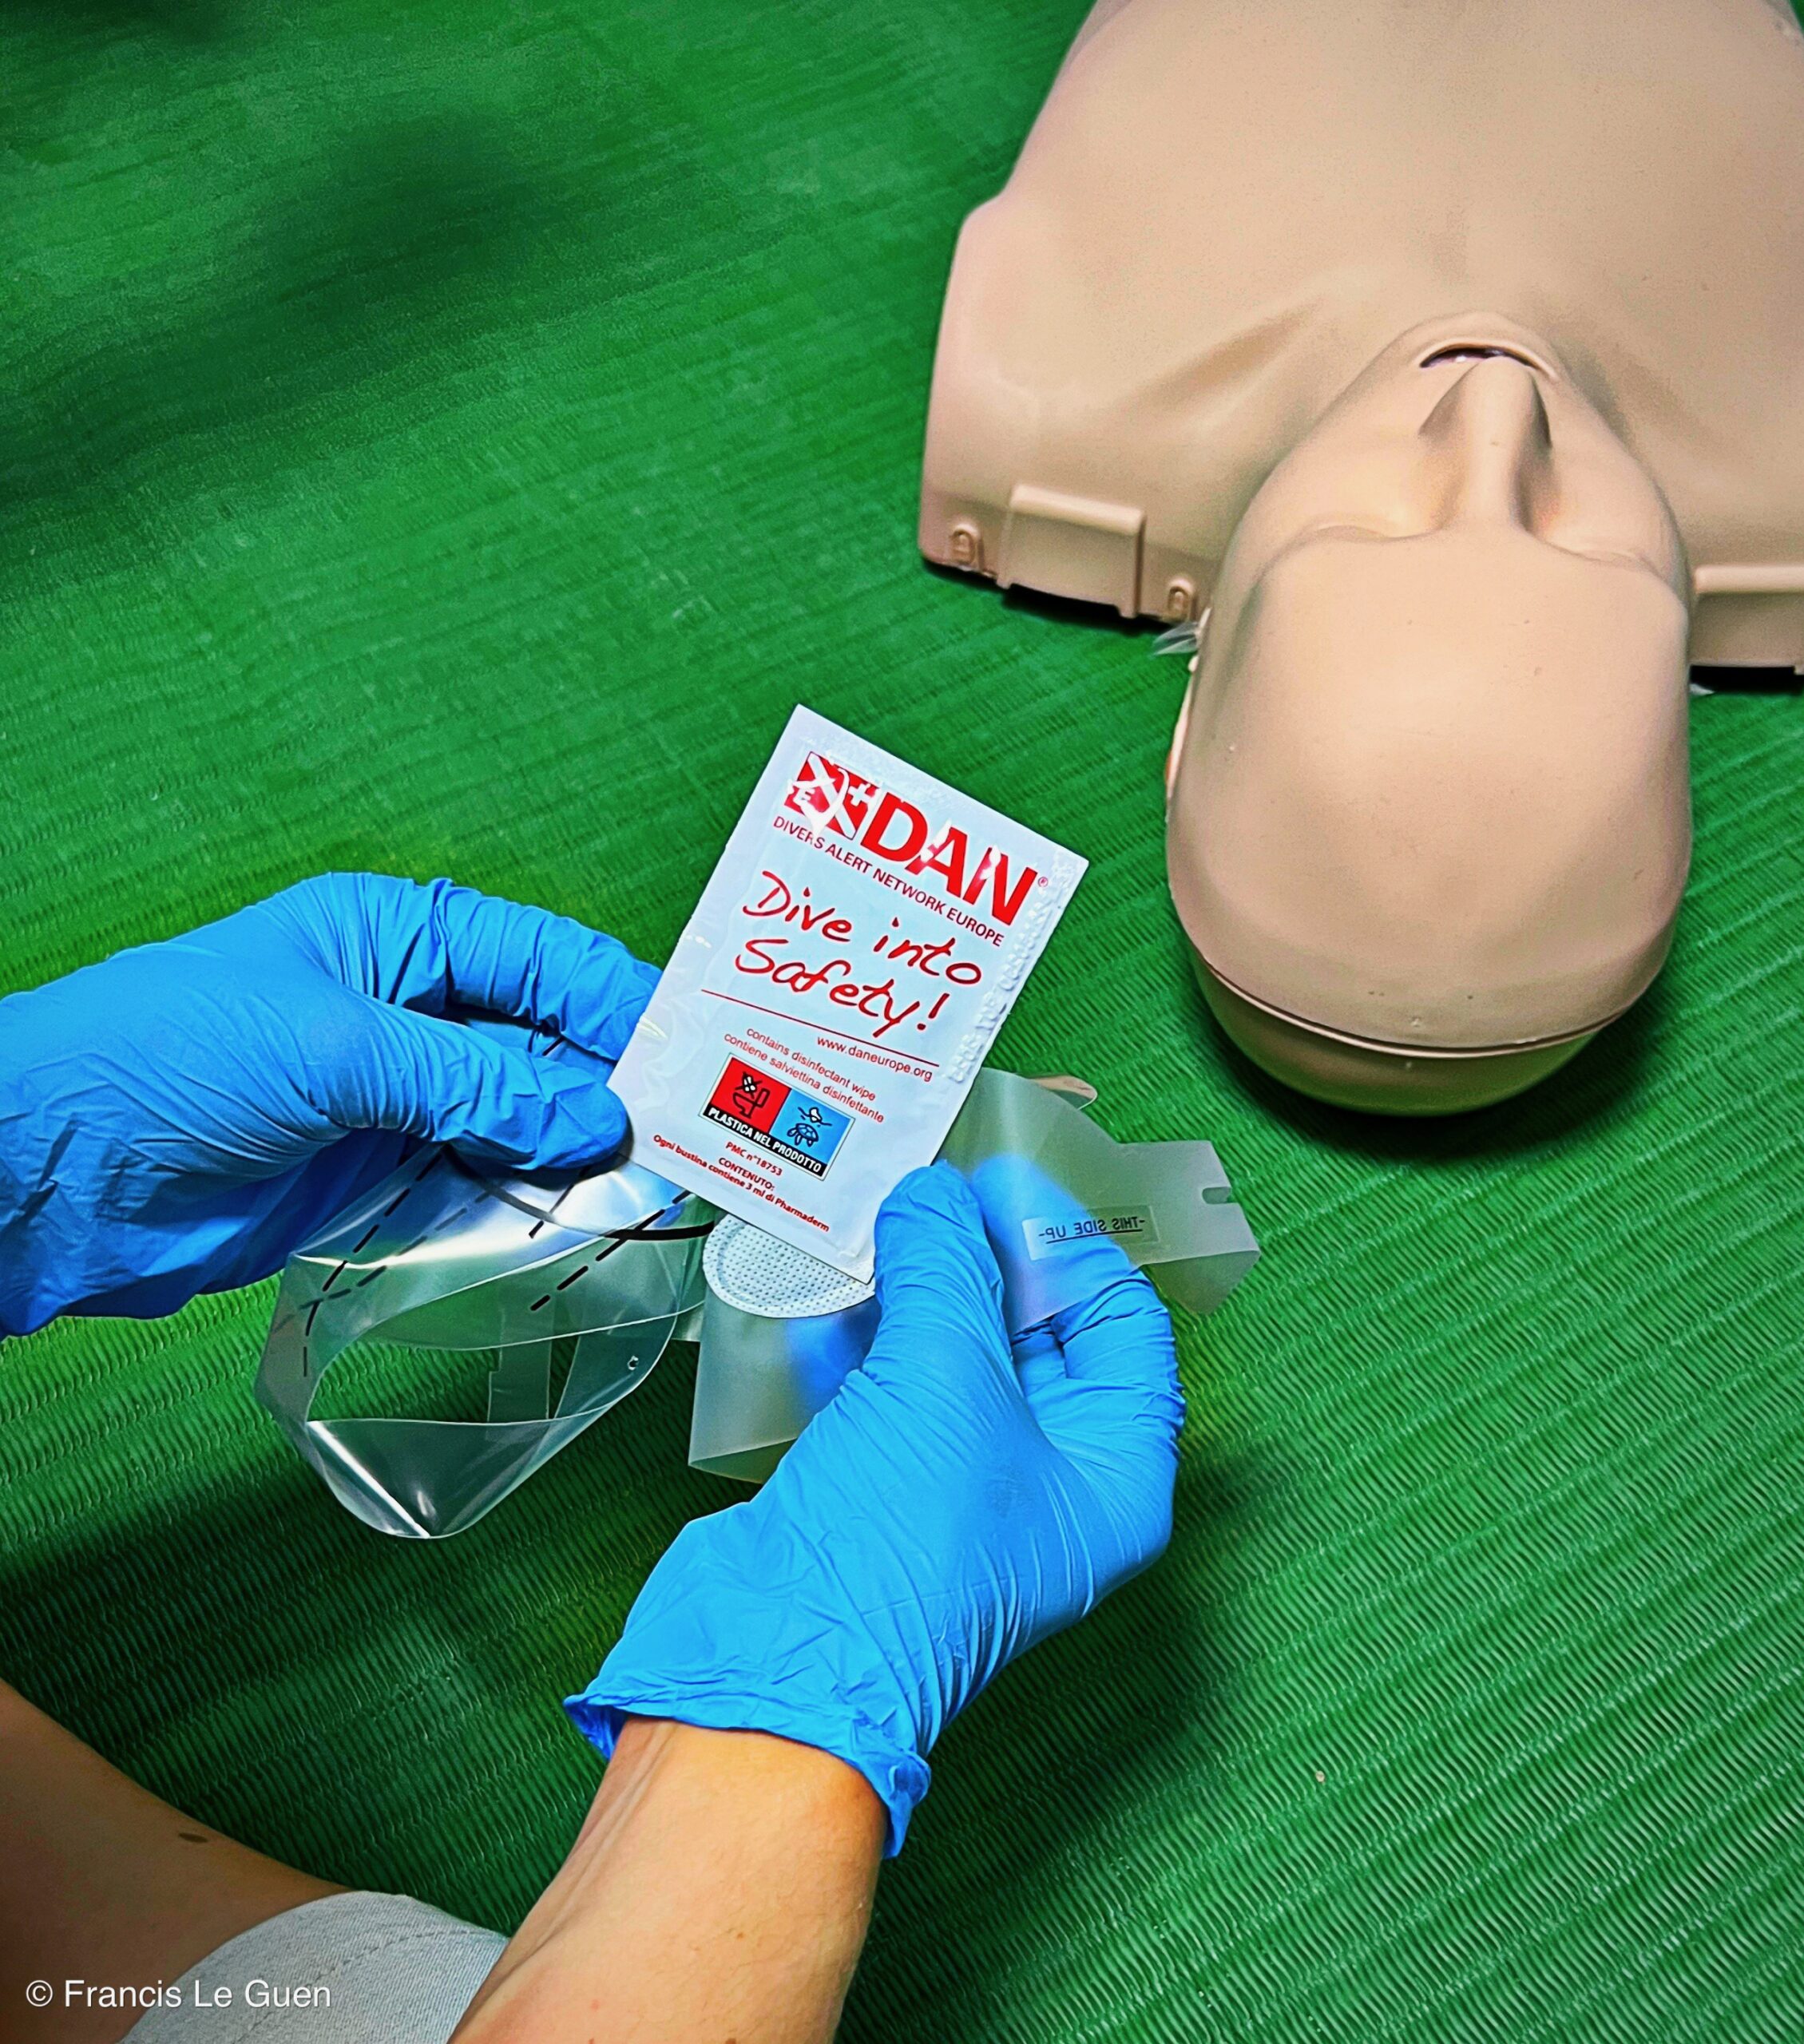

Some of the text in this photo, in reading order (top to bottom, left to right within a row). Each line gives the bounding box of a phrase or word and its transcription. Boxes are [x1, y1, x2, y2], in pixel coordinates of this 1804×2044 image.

[773, 815, 1005, 946] DIVERS ALERT NETWORK EUROPE
[860, 791, 1038, 925] DAN
[743, 870, 981, 984] Dive into
[735, 938, 950, 1038] Safety!
[724, 1033, 884, 1123] contiene salviettina disinfettante
[747, 1028, 876, 1101] contains disinfectant wipe
[817, 1036, 933, 1082] www.daneurope.org
[653, 1135, 830, 1232] Ogni bustina contiene 3 ml di Pharmaderm
[708, 1107, 822, 1173] PLASTICA NEL PRODOTTO
[718, 1157, 775, 1190] CONTENUTO:
[725, 1142, 746, 1157] PMC
